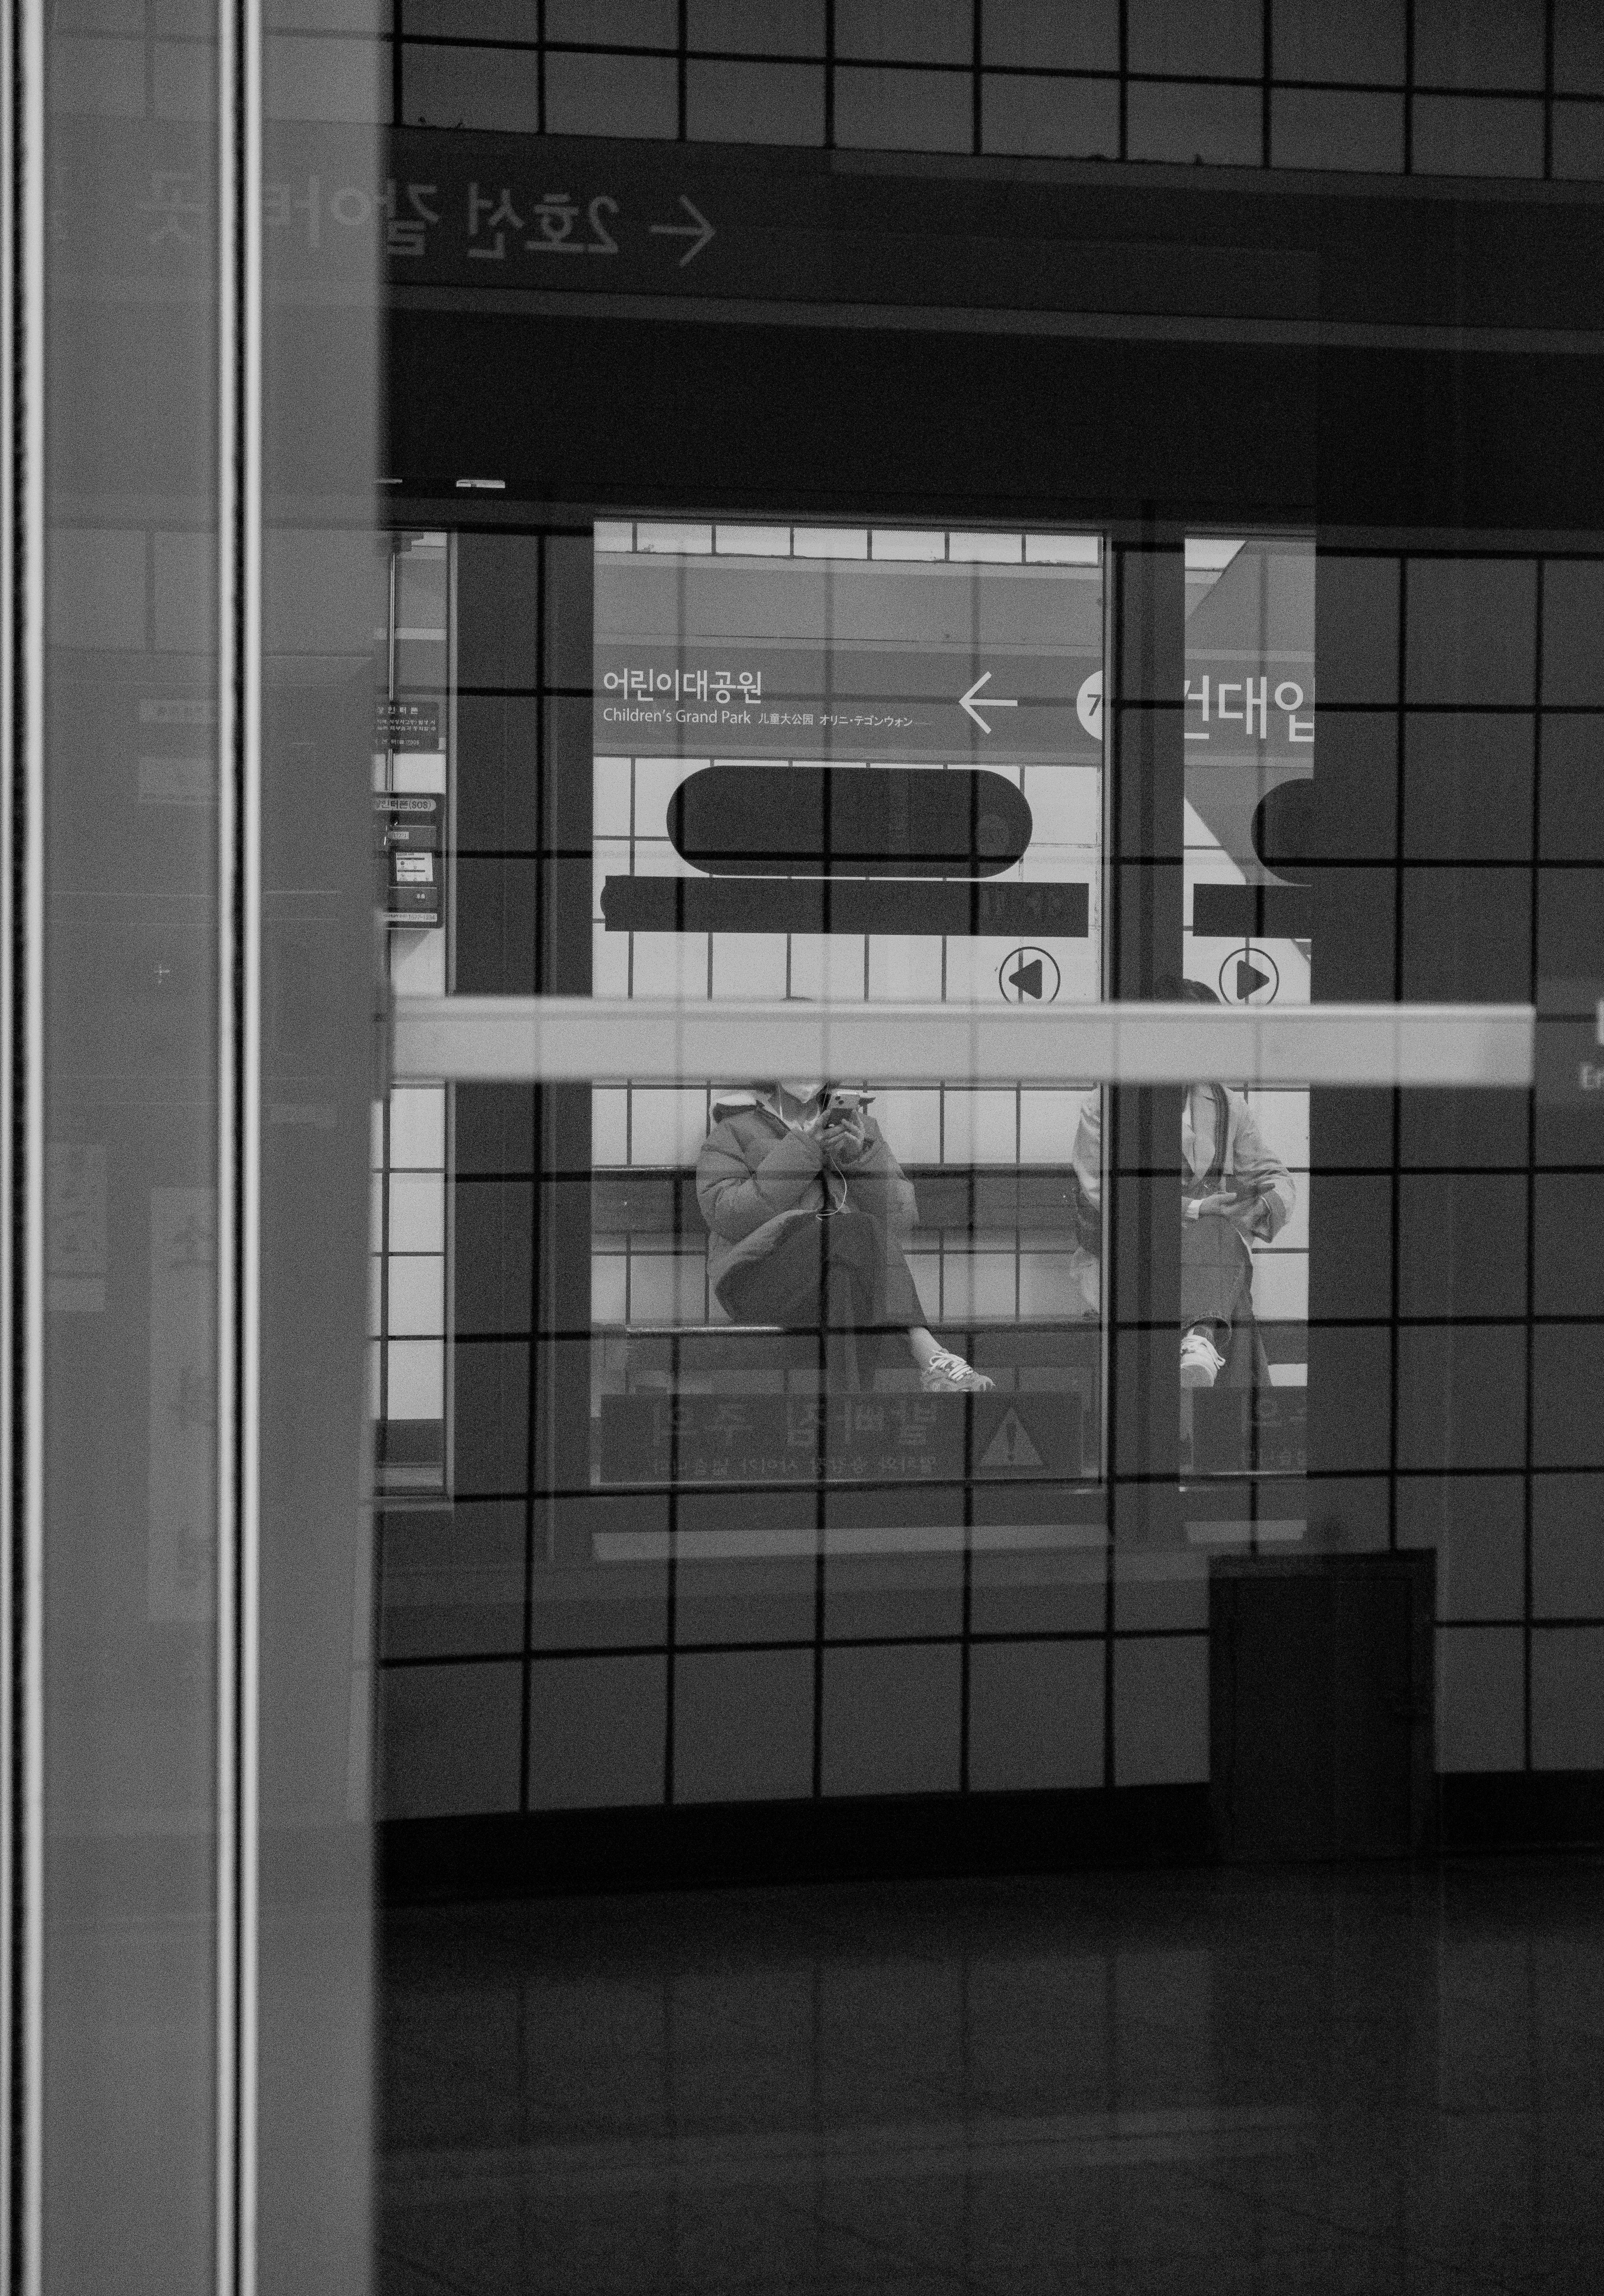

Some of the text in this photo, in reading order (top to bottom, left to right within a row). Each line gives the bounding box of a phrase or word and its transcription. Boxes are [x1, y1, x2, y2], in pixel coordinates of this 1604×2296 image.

[604, 668, 761, 704] 어린이대공원
[1087, 694, 1102, 716] 7
[604, 708, 671, 722] Children's
[676, 709, 718, 723] Grand
[722, 710, 751, 724] Park
[758, 713, 813, 726] 儿童大公园
